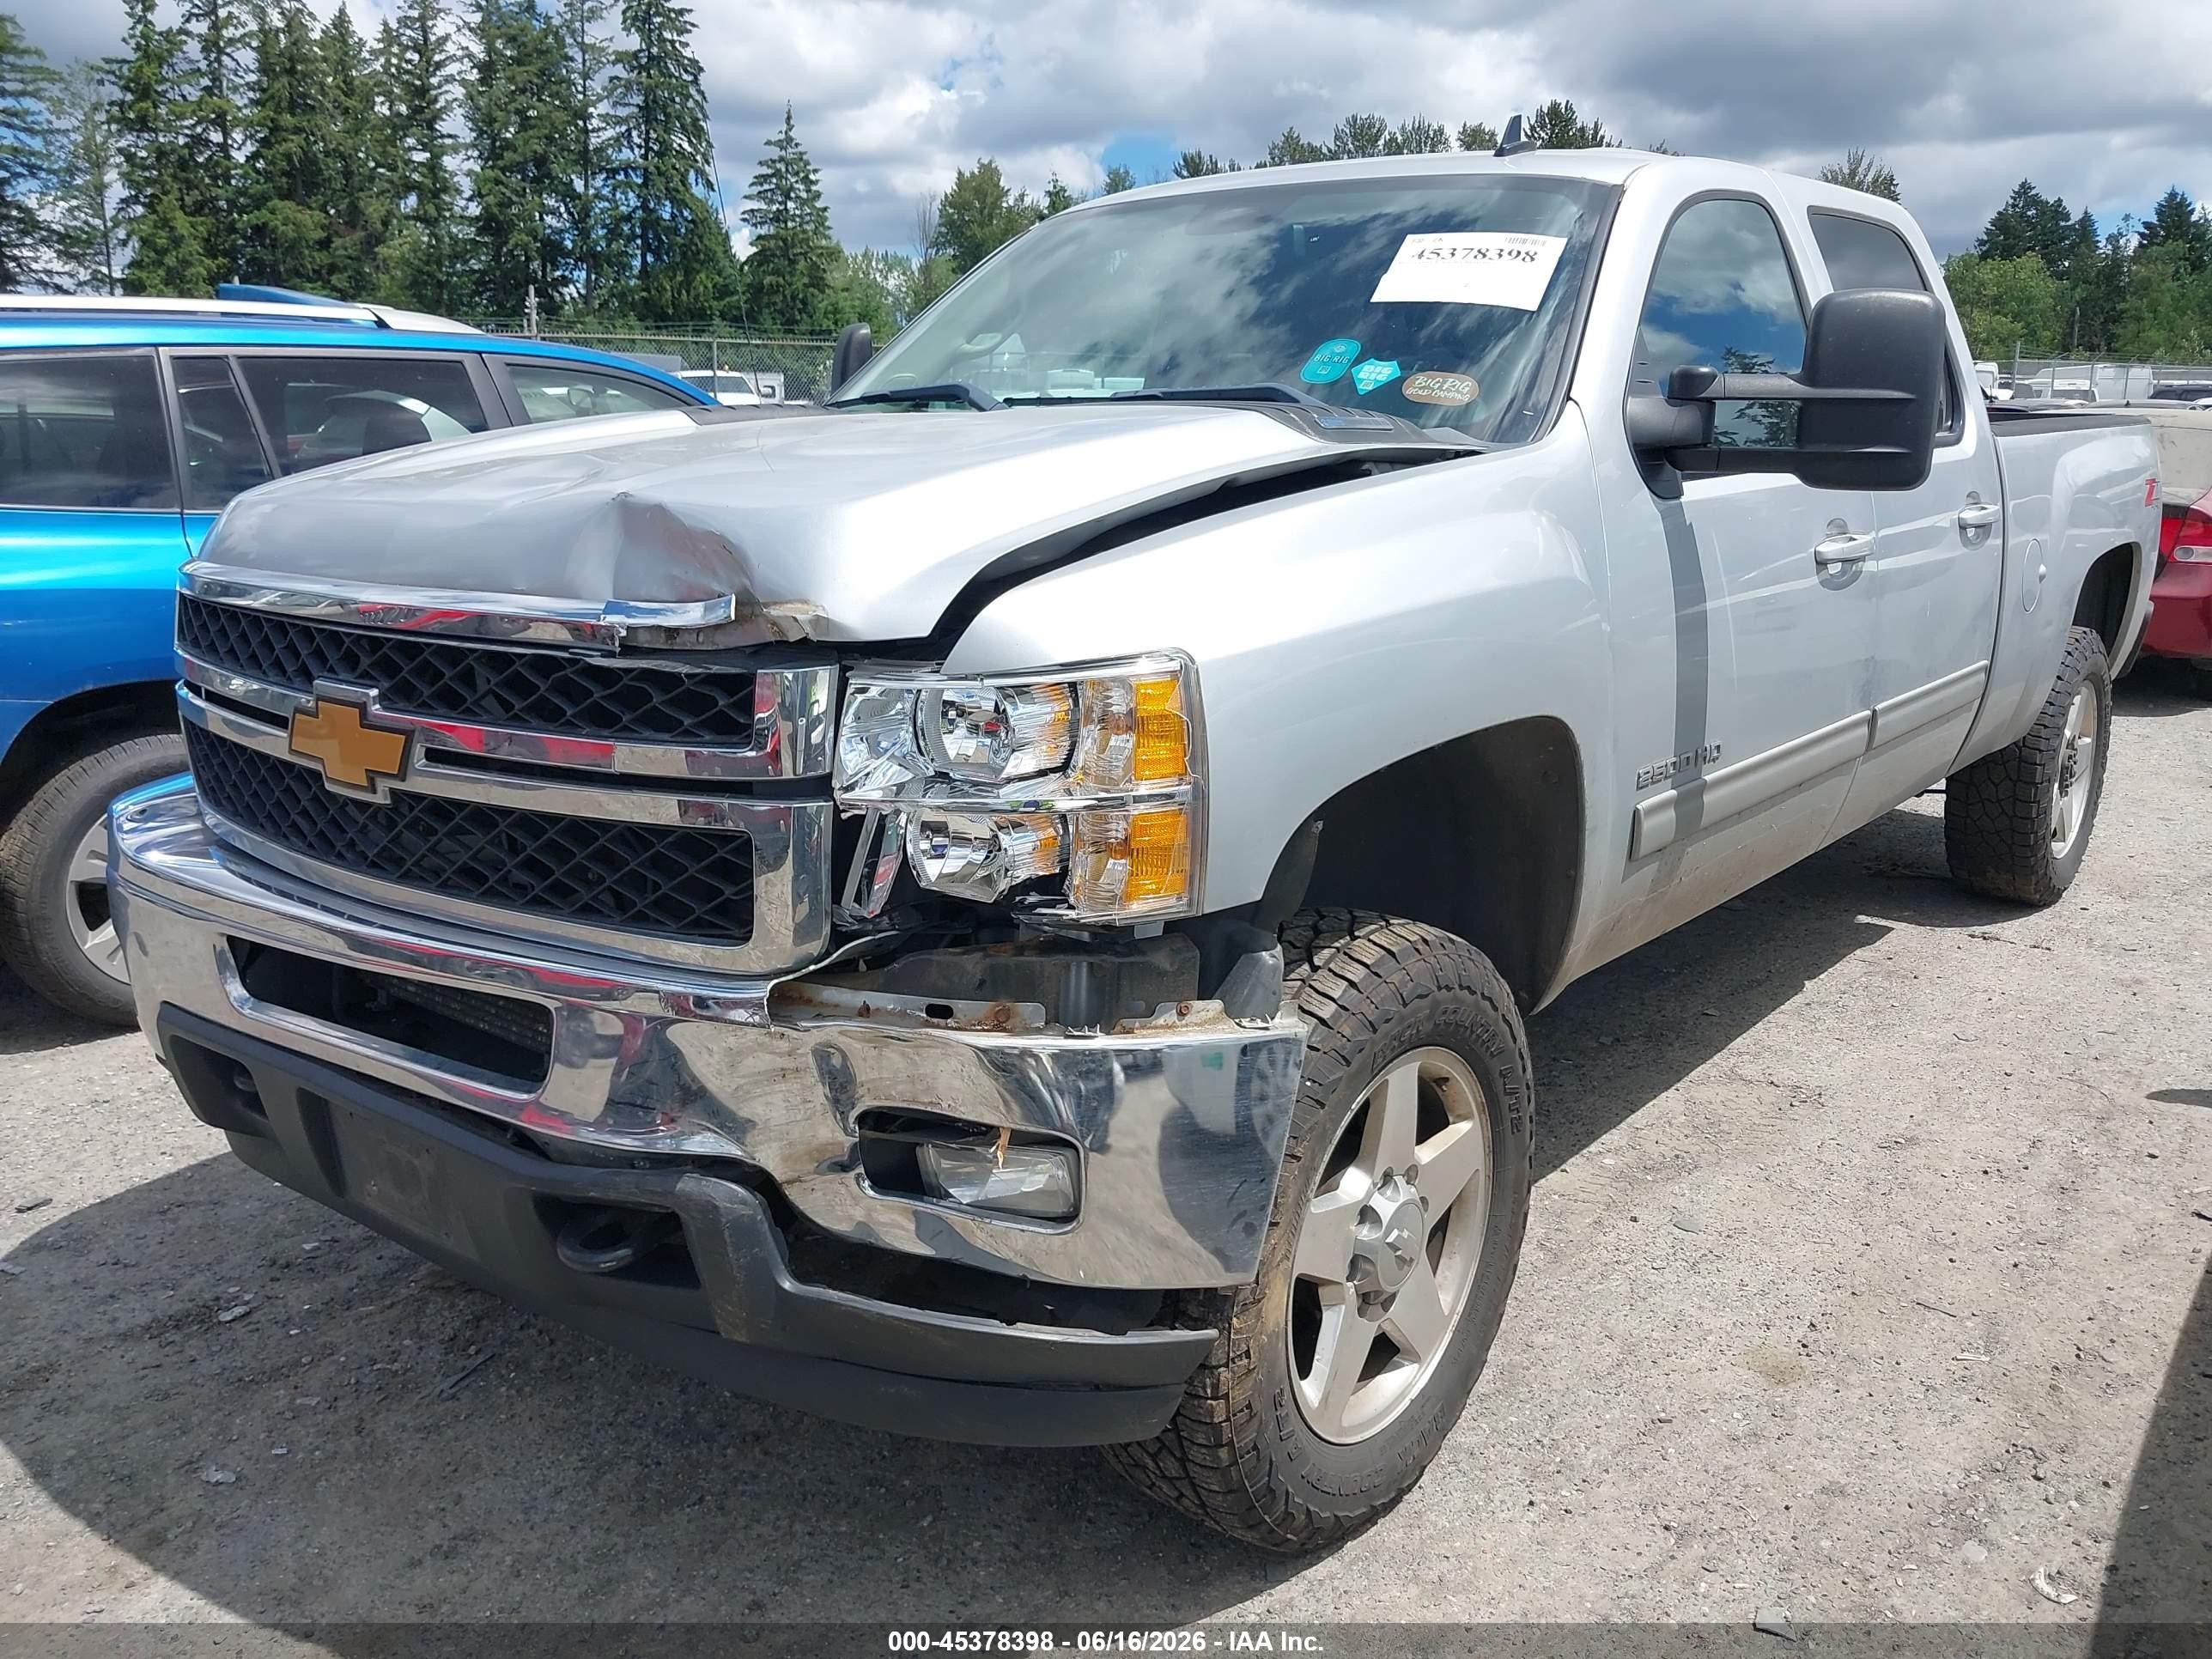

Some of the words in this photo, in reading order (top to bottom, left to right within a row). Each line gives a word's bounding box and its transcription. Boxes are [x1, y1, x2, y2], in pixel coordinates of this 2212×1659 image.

[1411, 246, 1539, 263] 45378398
[1313, 354, 1331, 362] BIG
[1332, 355, 1350, 364] RIG
[1361, 364, 1394, 374] BIG
[1413, 375, 1443, 390] BIG
[1443, 378, 1472, 394] RIG
[1433, 1006, 1505, 1058] COUNTRY
[1301, 1463, 1386, 1498] COUNTRY
